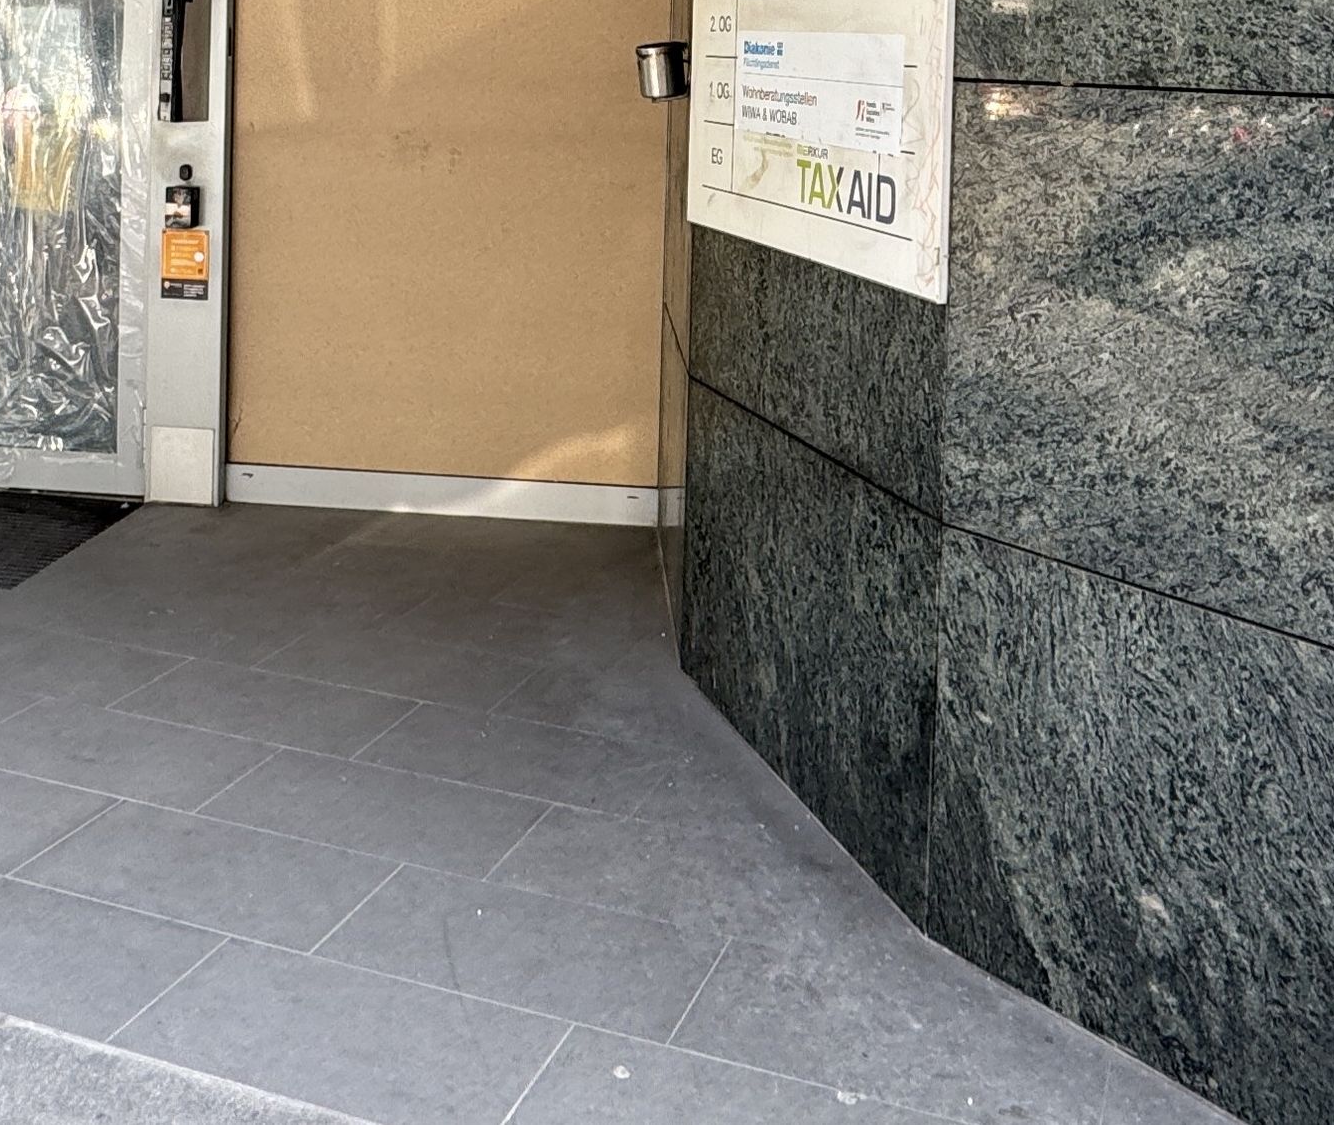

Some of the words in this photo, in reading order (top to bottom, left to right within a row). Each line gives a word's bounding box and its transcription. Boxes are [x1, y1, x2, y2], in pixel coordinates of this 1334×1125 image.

[710, 15, 717, 32] 2.
[718, 15, 732, 33] OG
[744, 40, 775, 56] Diakonie
[709, 81, 716, 98] 1.
[717, 81, 730, 100] OG
[742, 85, 818, 107] Wohnberatungsstellen
[762, 108, 768, 121] &
[711, 147, 724, 165] EG
